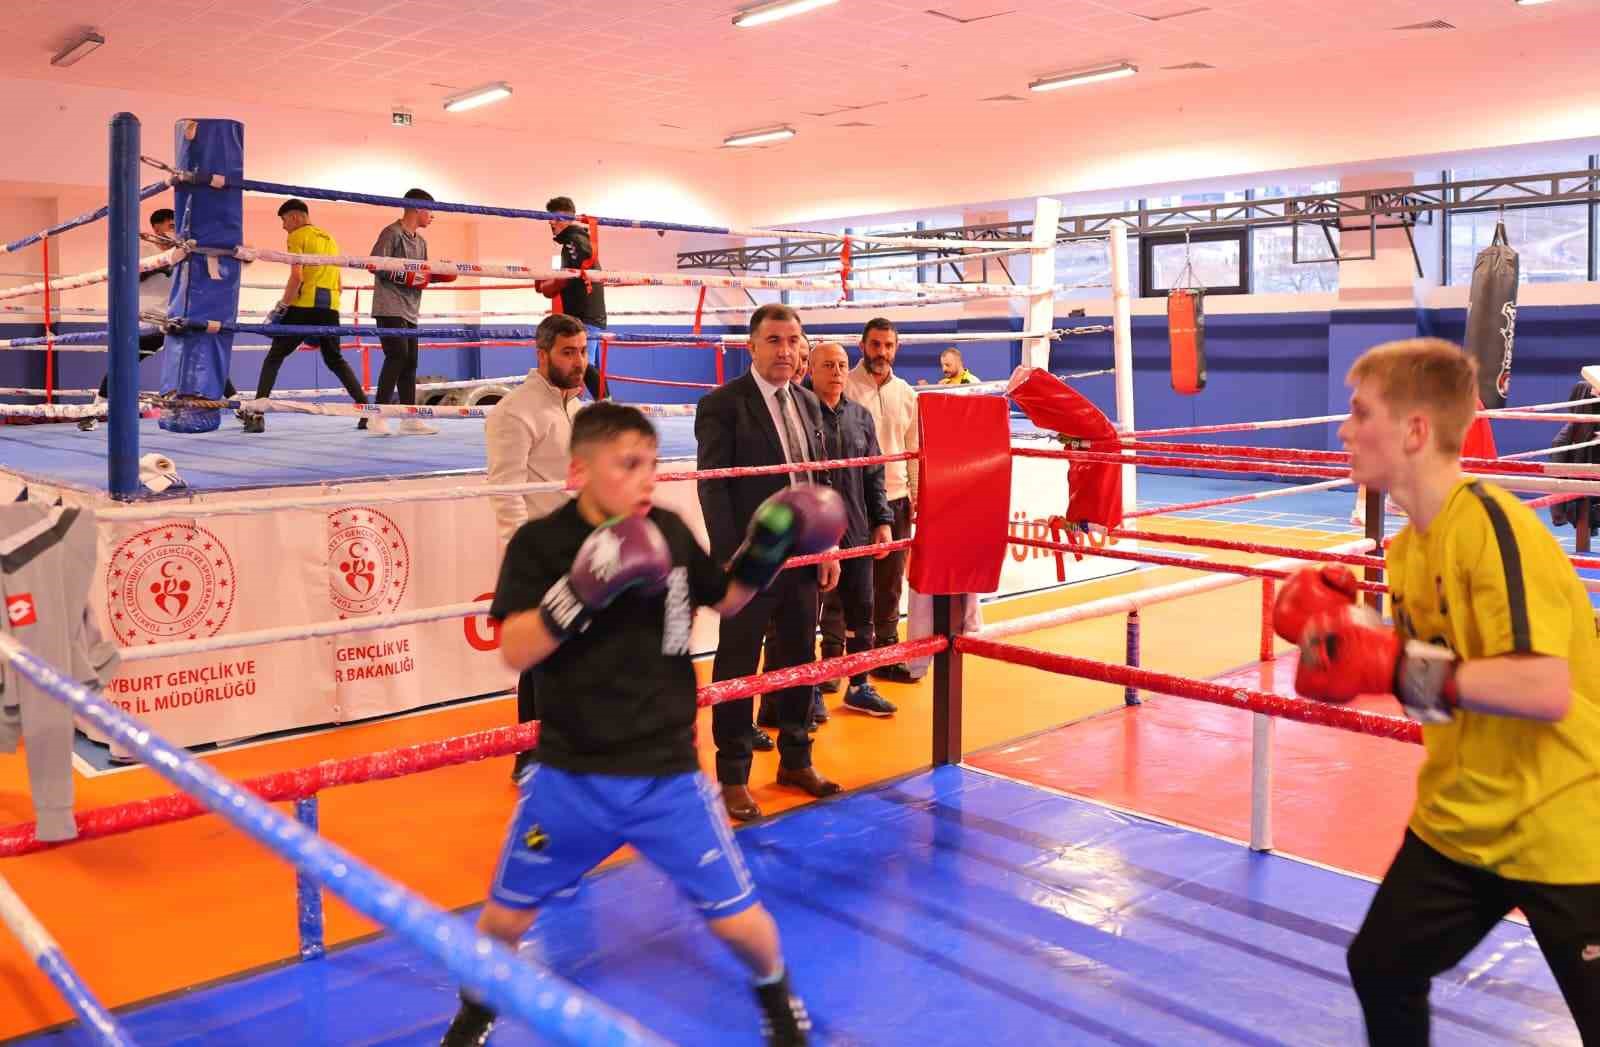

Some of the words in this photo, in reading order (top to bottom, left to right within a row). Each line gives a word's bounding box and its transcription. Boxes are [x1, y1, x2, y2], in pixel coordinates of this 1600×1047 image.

[464, 592, 504, 651] G
[336, 641, 394, 662] GENÇLİK
[396, 640, 409, 654] VE
[107, 674, 163, 693] YBURT
[167, 662, 233, 687] GENÇLİK
[236, 660, 256, 676] VE
[336, 670, 344, 682] R
[347, 657, 414, 681] BAKANLIĞI
[136, 696, 150, 714] İL
[154, 679, 256, 712] MÜDÜRLÜĞÜ
